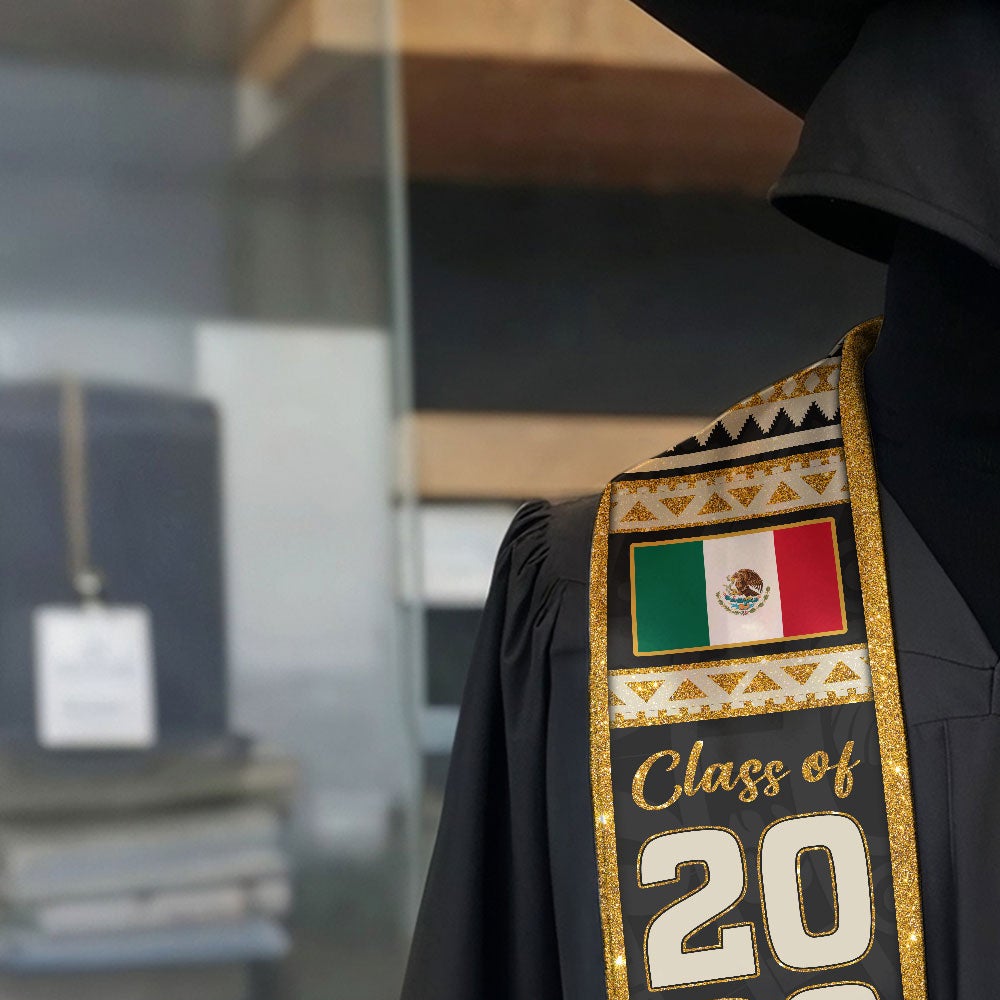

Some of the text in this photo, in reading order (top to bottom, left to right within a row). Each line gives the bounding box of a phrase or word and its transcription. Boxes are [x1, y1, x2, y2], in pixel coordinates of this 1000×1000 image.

[631, 740, 861, 811] Class of
[637, 811, 875, 992] 20
